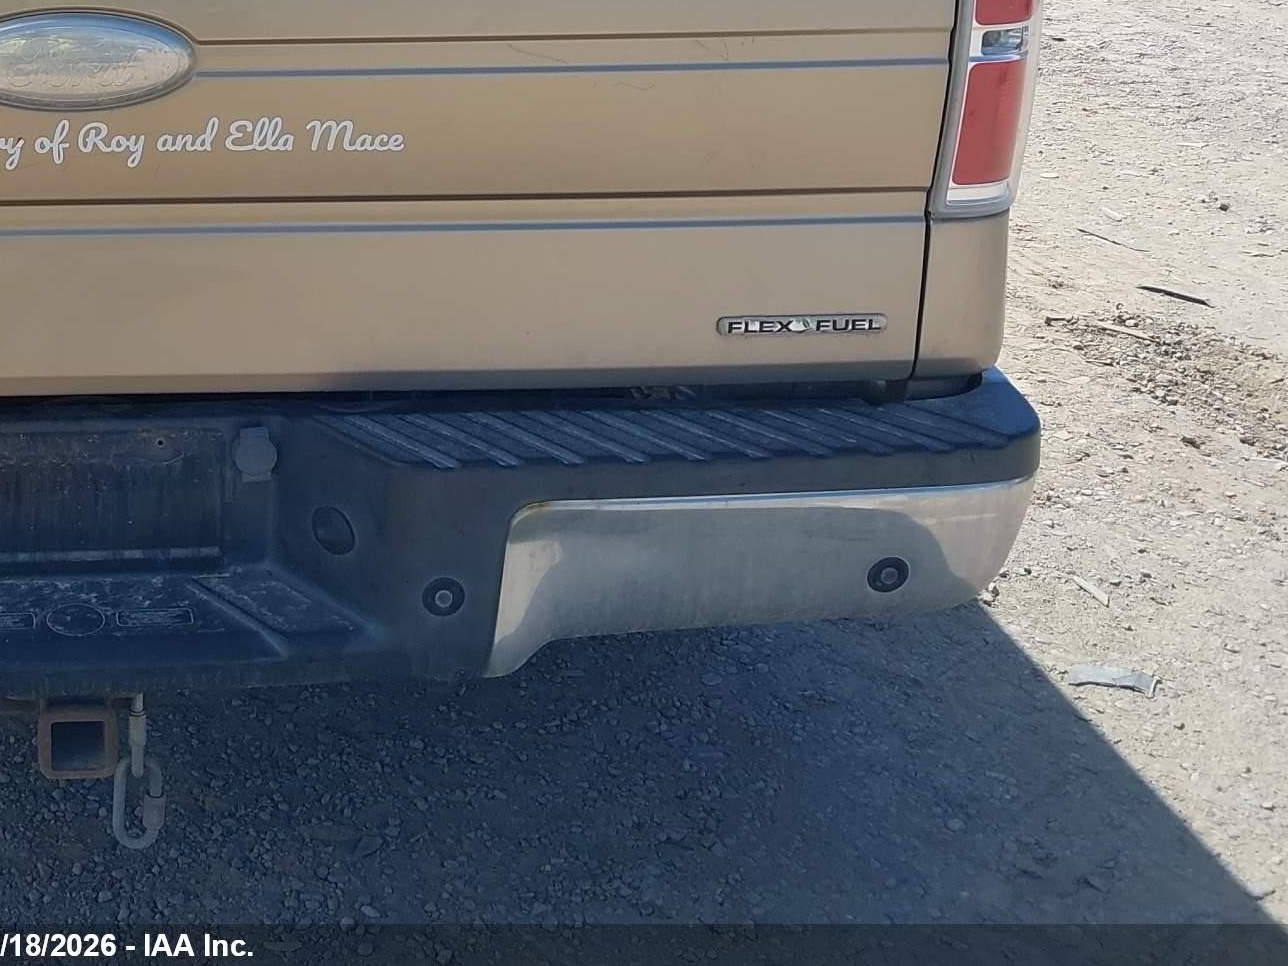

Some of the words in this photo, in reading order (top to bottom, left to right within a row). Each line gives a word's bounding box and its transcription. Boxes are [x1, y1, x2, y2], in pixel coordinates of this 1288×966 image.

[34, 119, 70, 164] of
[78, 121, 145, 168] Roy
[157, 117, 219, 152] and
[224, 117, 295, 152] Ella
[306, 119, 405, 152] Mace
[727, 320, 794, 334] FLEX
[815, 318, 882, 332] FUEL
